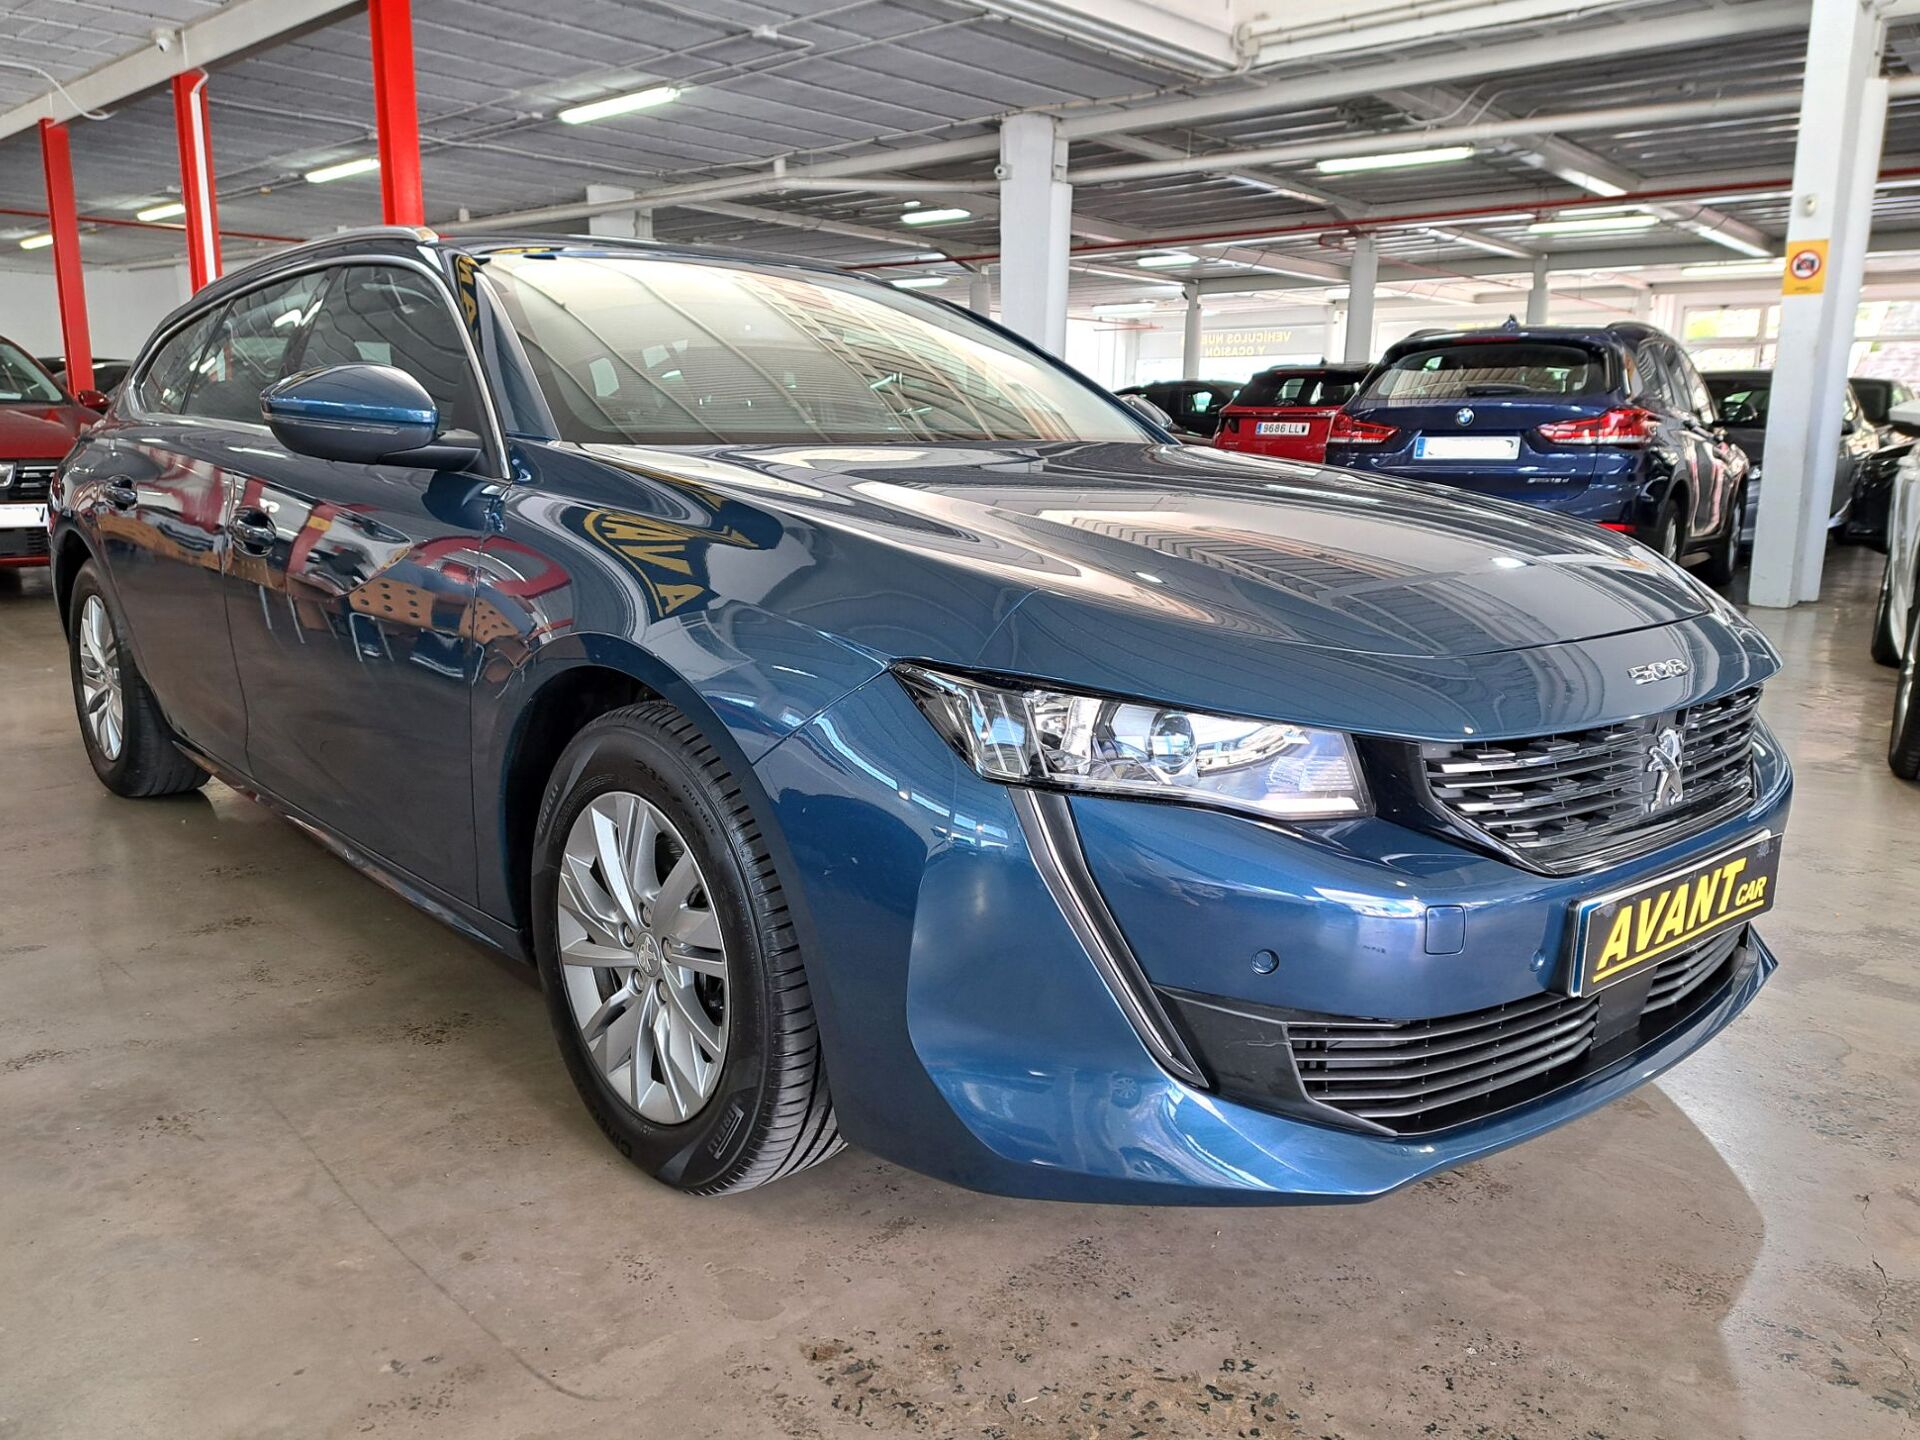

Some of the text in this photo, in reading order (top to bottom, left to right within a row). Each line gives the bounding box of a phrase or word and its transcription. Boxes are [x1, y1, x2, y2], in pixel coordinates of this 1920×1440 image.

[1263, 424, 1286, 433] 9686
[1596, 857, 1768, 971] AVANT CAR
